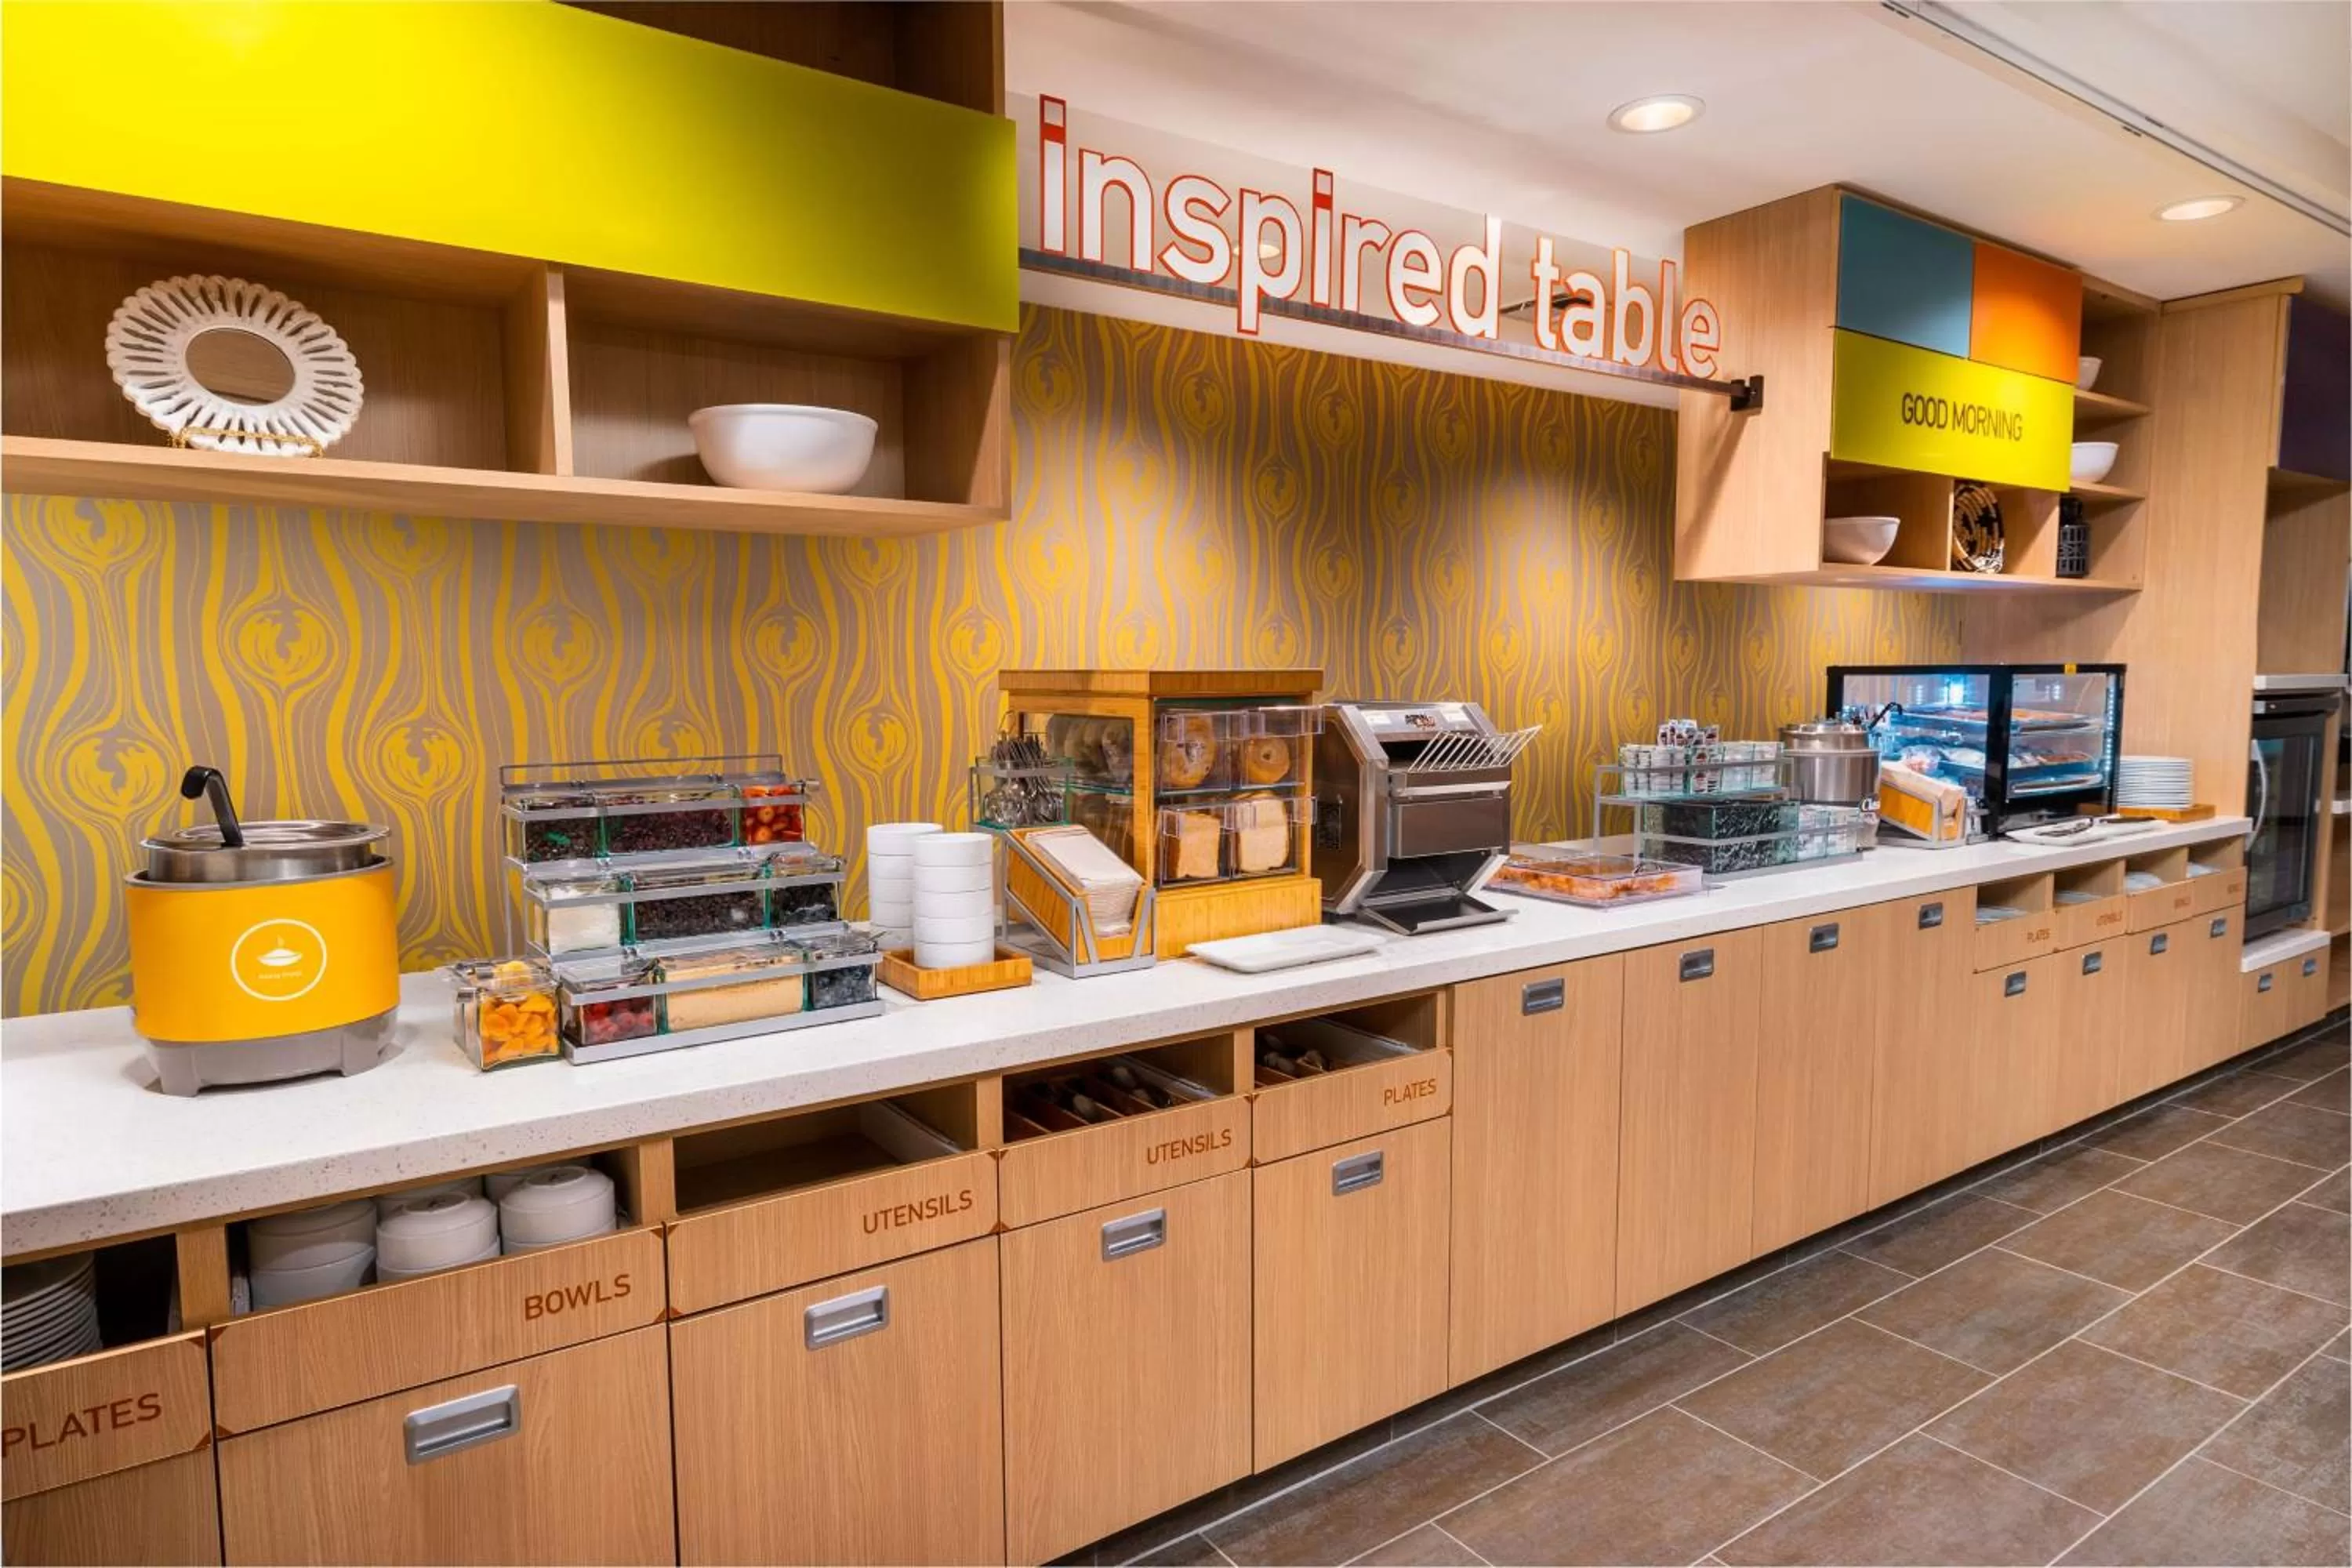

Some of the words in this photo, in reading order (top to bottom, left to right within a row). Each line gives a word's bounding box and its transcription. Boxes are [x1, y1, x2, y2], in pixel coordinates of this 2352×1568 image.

[1039, 93, 1502, 339] inspired
[1530, 236, 1721, 379] table
[1902, 393, 1948, 429] GOOD
[1952, 401, 2023, 441] MORNING
[1383, 1078, 1436, 1106] PLATES
[1147, 1128, 1232, 1164] UTENSILS
[862, 1189, 973, 1234] UTENSILS
[524, 1273, 631, 1322] BOWLS
[2, 1392, 162, 1458] PLATES
